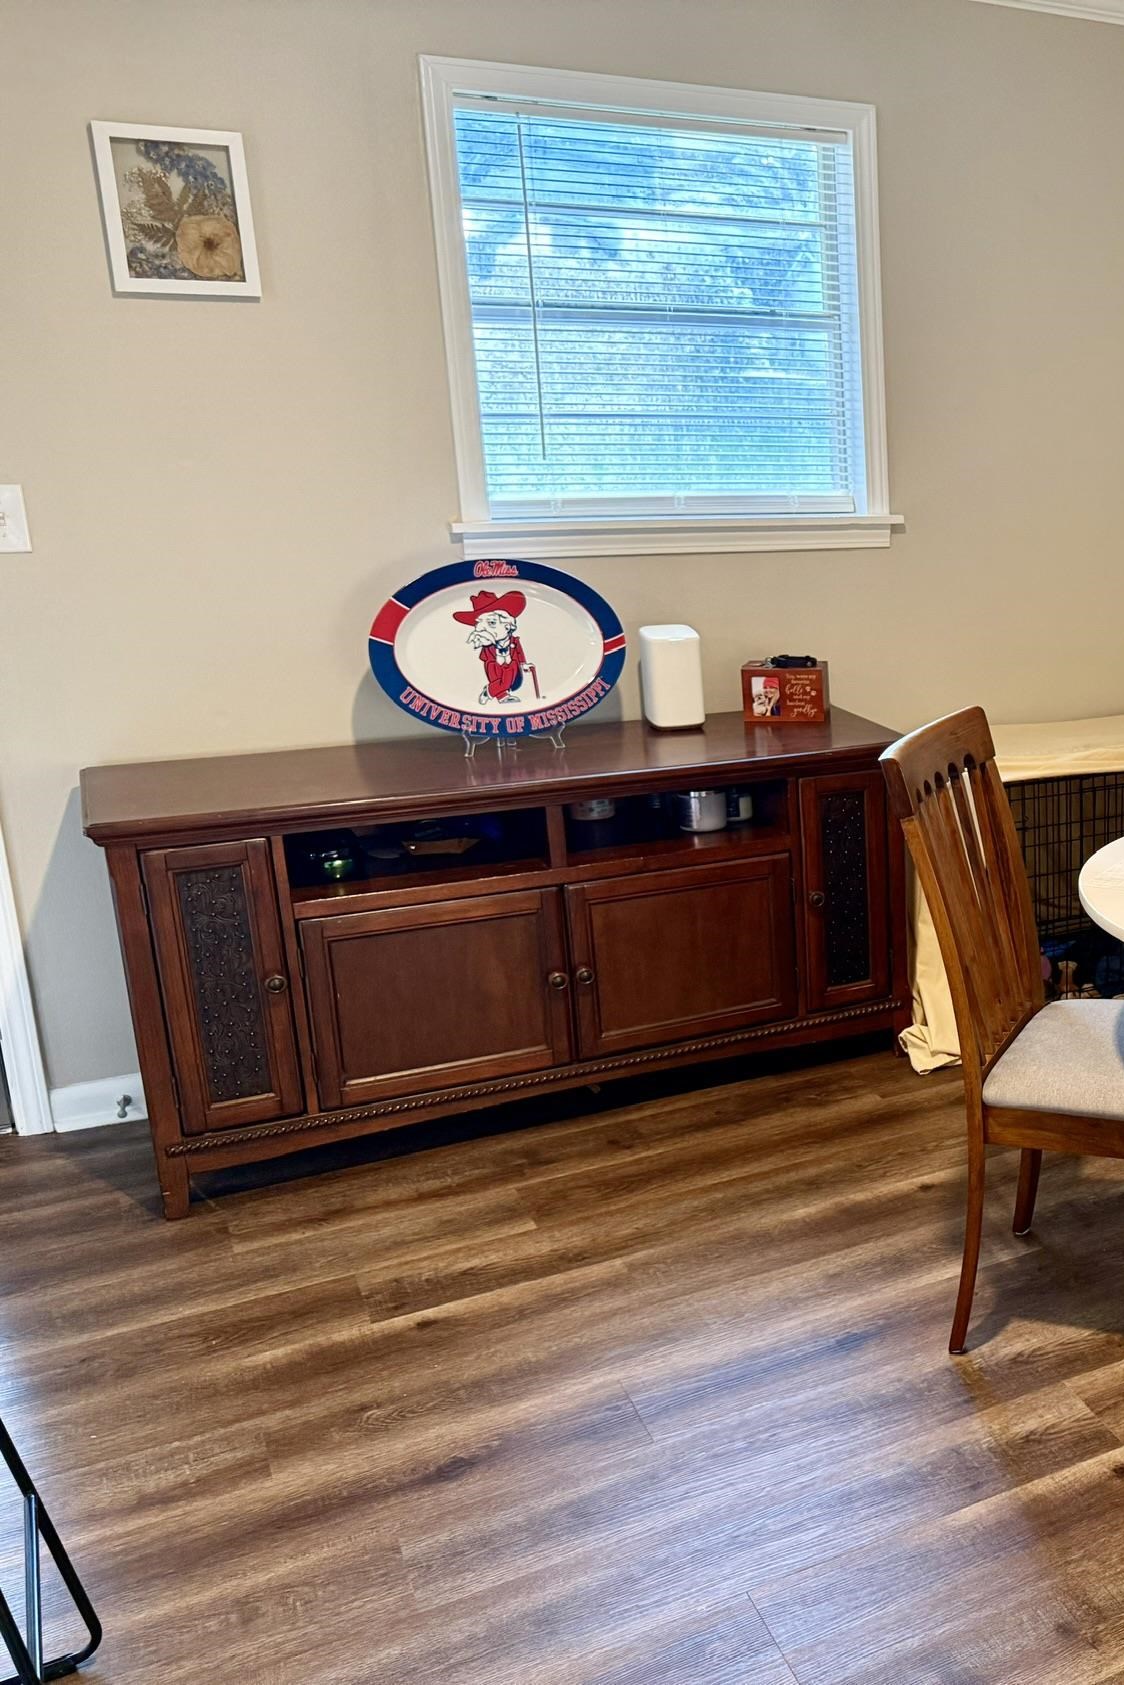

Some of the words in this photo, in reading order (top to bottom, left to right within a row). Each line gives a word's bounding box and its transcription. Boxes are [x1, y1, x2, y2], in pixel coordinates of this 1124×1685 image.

[400, 686, 501, 734] UNIVERSITY
[506, 716, 525, 734] OF
[530, 677, 612, 731] MISSISSIPPI
